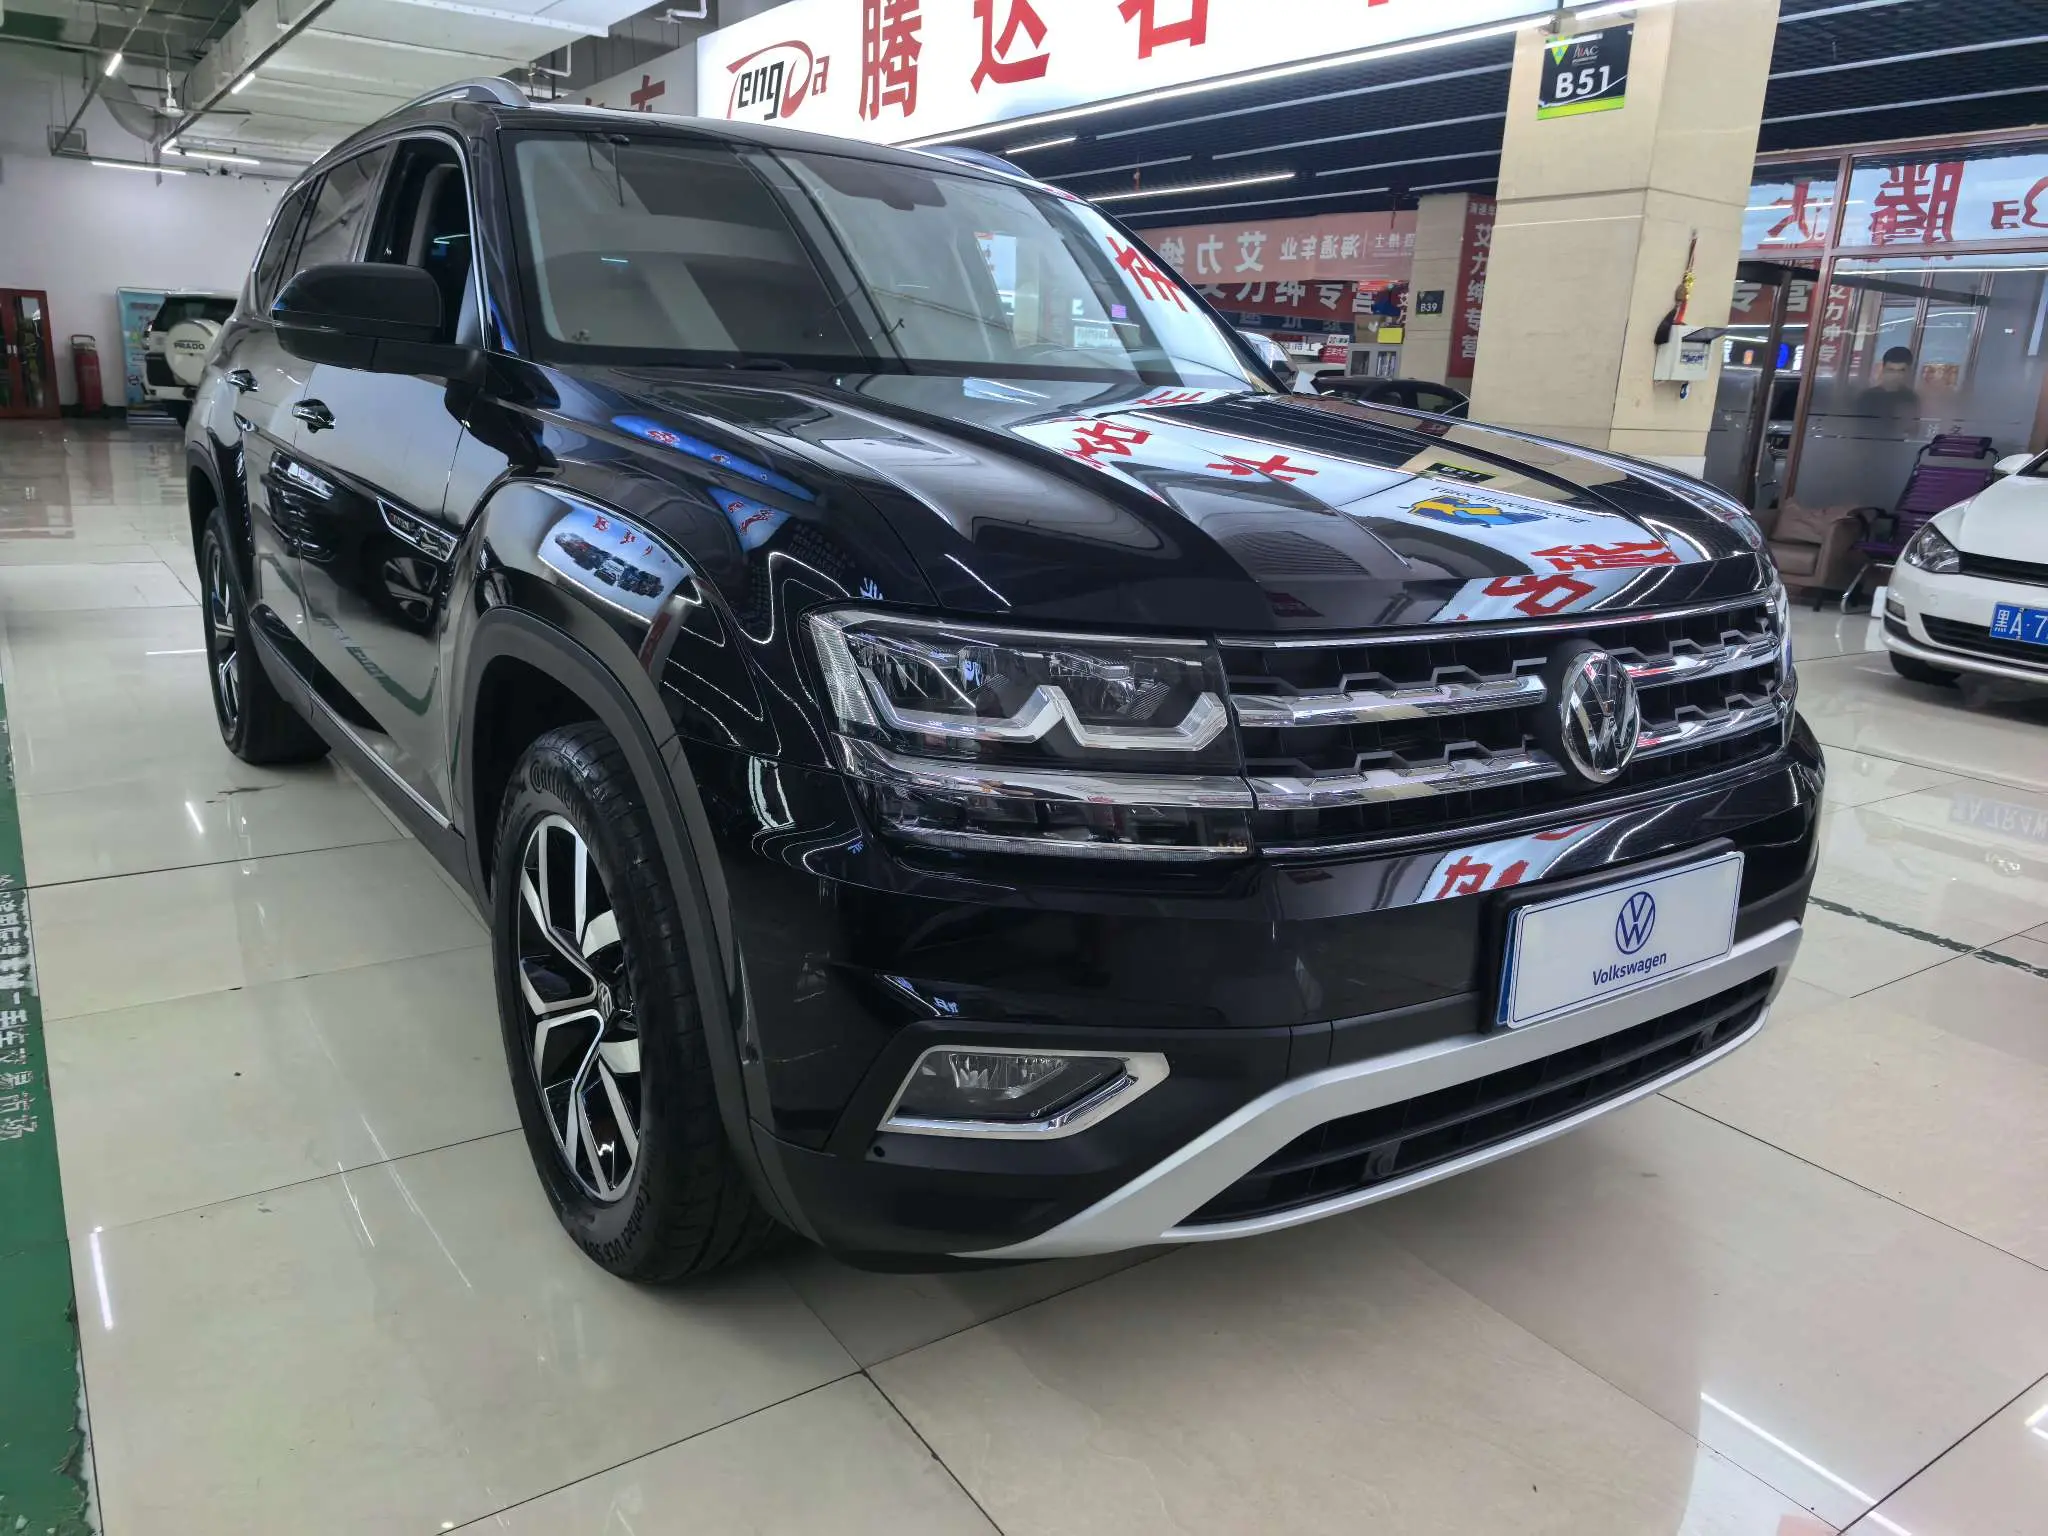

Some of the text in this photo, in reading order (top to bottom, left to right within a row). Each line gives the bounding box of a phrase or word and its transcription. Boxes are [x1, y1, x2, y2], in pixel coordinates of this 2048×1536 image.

[1555, 65, 1612, 99] B51
[1420, 302, 1438, 312] B39
[173, 341, 205, 351] PRADO
[1993, 609, 2048, 639] 黑A·7
[1592, 952, 1667, 986] Volkswagen
